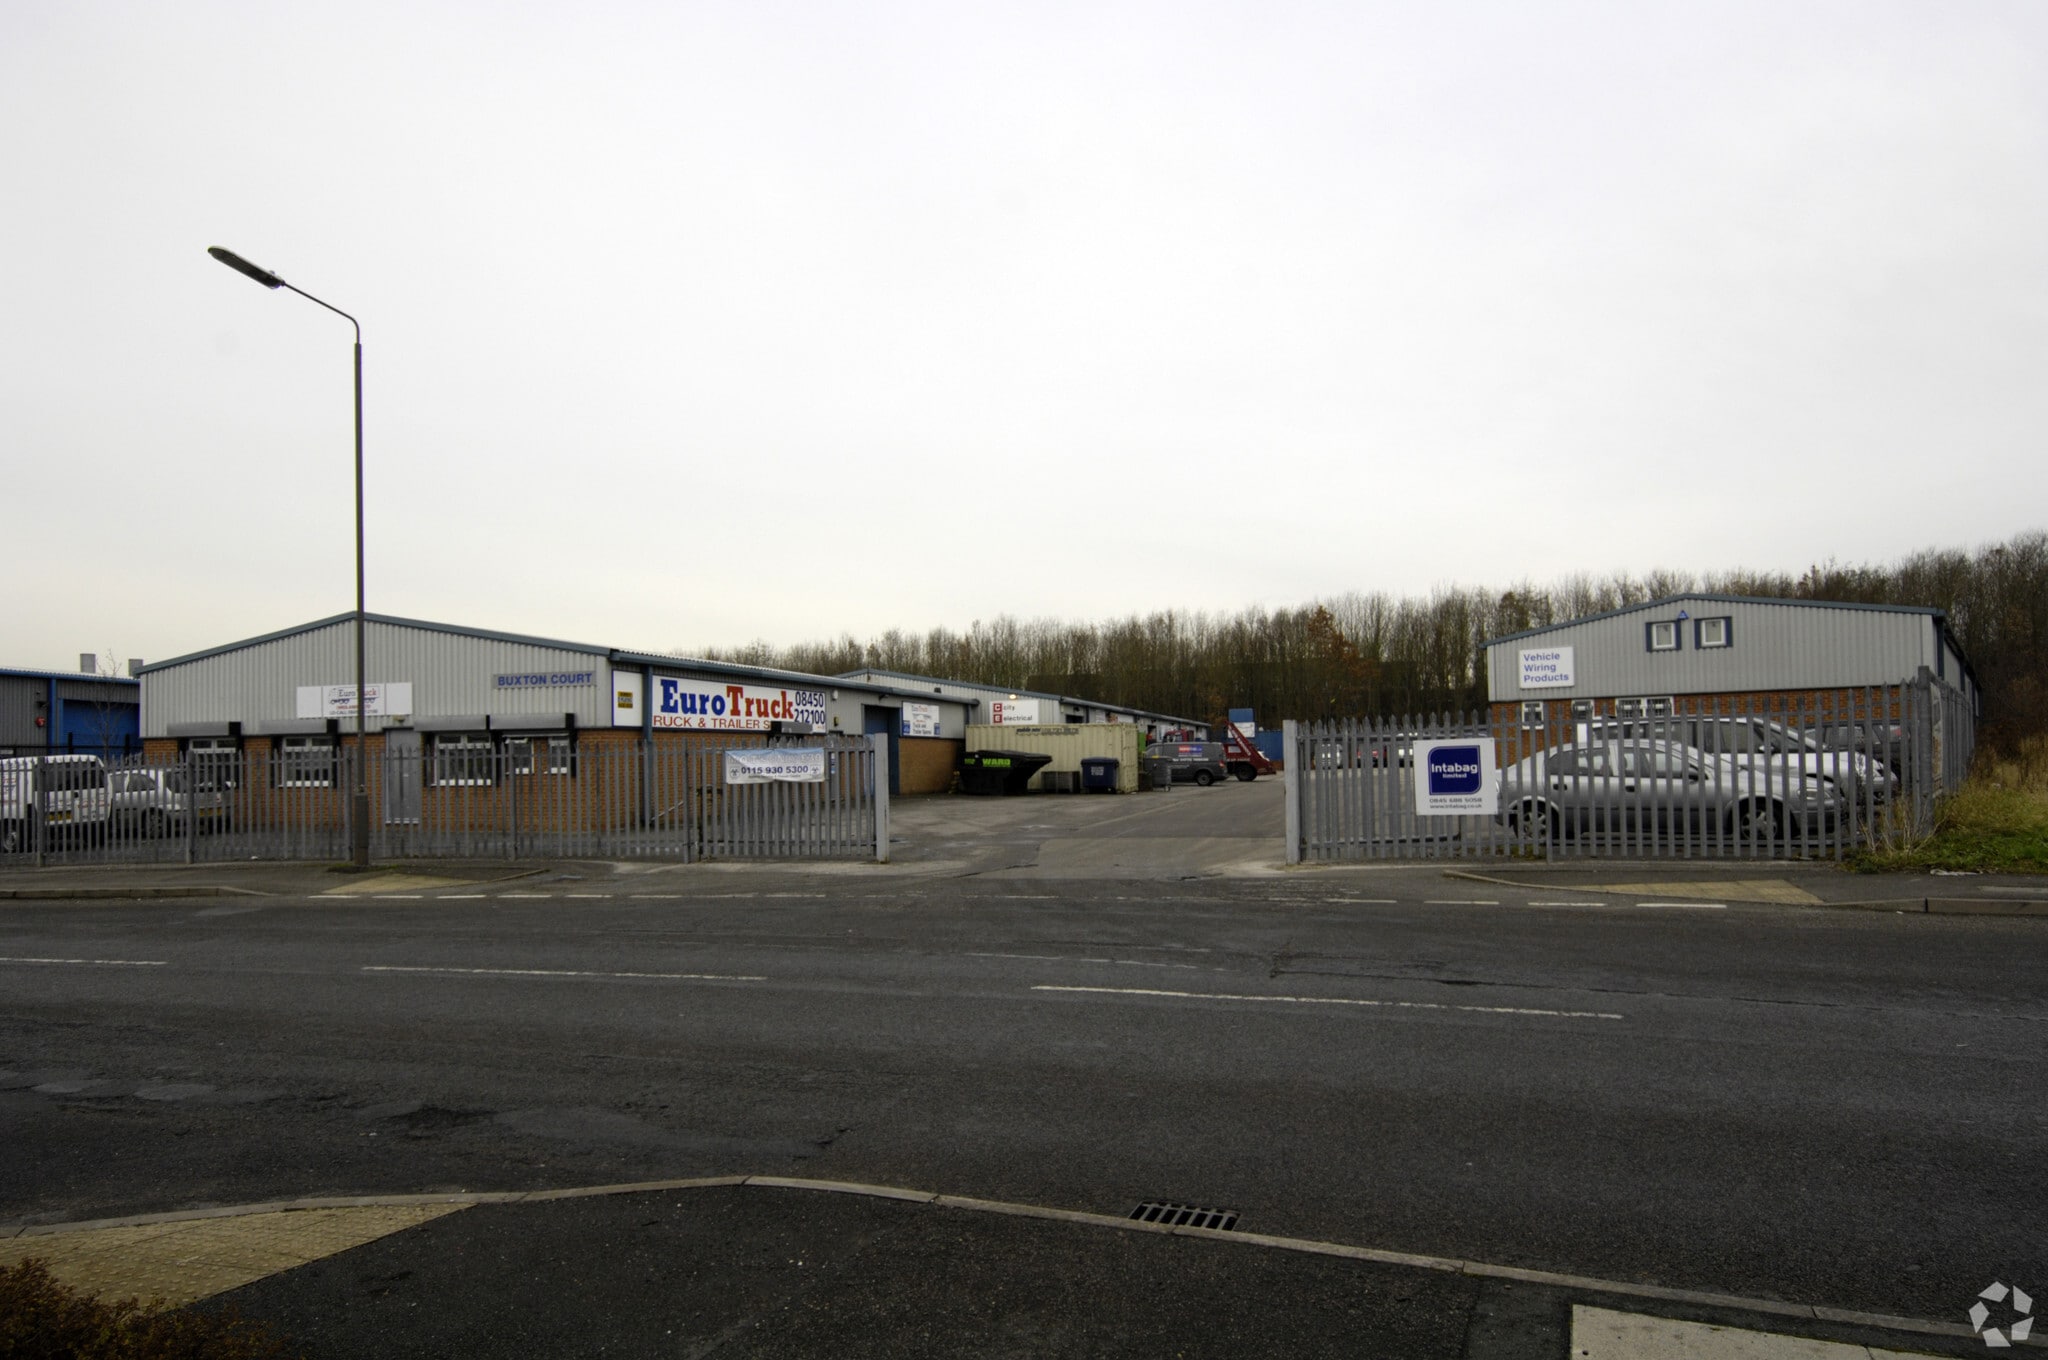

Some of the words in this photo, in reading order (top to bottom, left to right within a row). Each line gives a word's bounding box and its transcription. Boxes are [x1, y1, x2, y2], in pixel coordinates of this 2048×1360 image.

[1523, 652, 1560, 661] Vehicle
[1523, 664, 1557, 673] Wiring
[498, 675, 547, 686] BUXTON
[551, 673, 593, 685] COURT
[1523, 673, 1570, 682] Products
[795, 691, 824, 708] 08450
[794, 708, 826, 725] 212100
[653, 715, 692, 727] RUCK
[697, 716, 706, 728] &
[711, 718, 760, 729] TRAILER
[982, 758, 1012, 767] WARD
[741, 766, 763, 774] 0115
[765, 766, 783, 774] 930
[786, 765, 809, 773] 5300
[1431, 763, 1478, 774] Intabag
